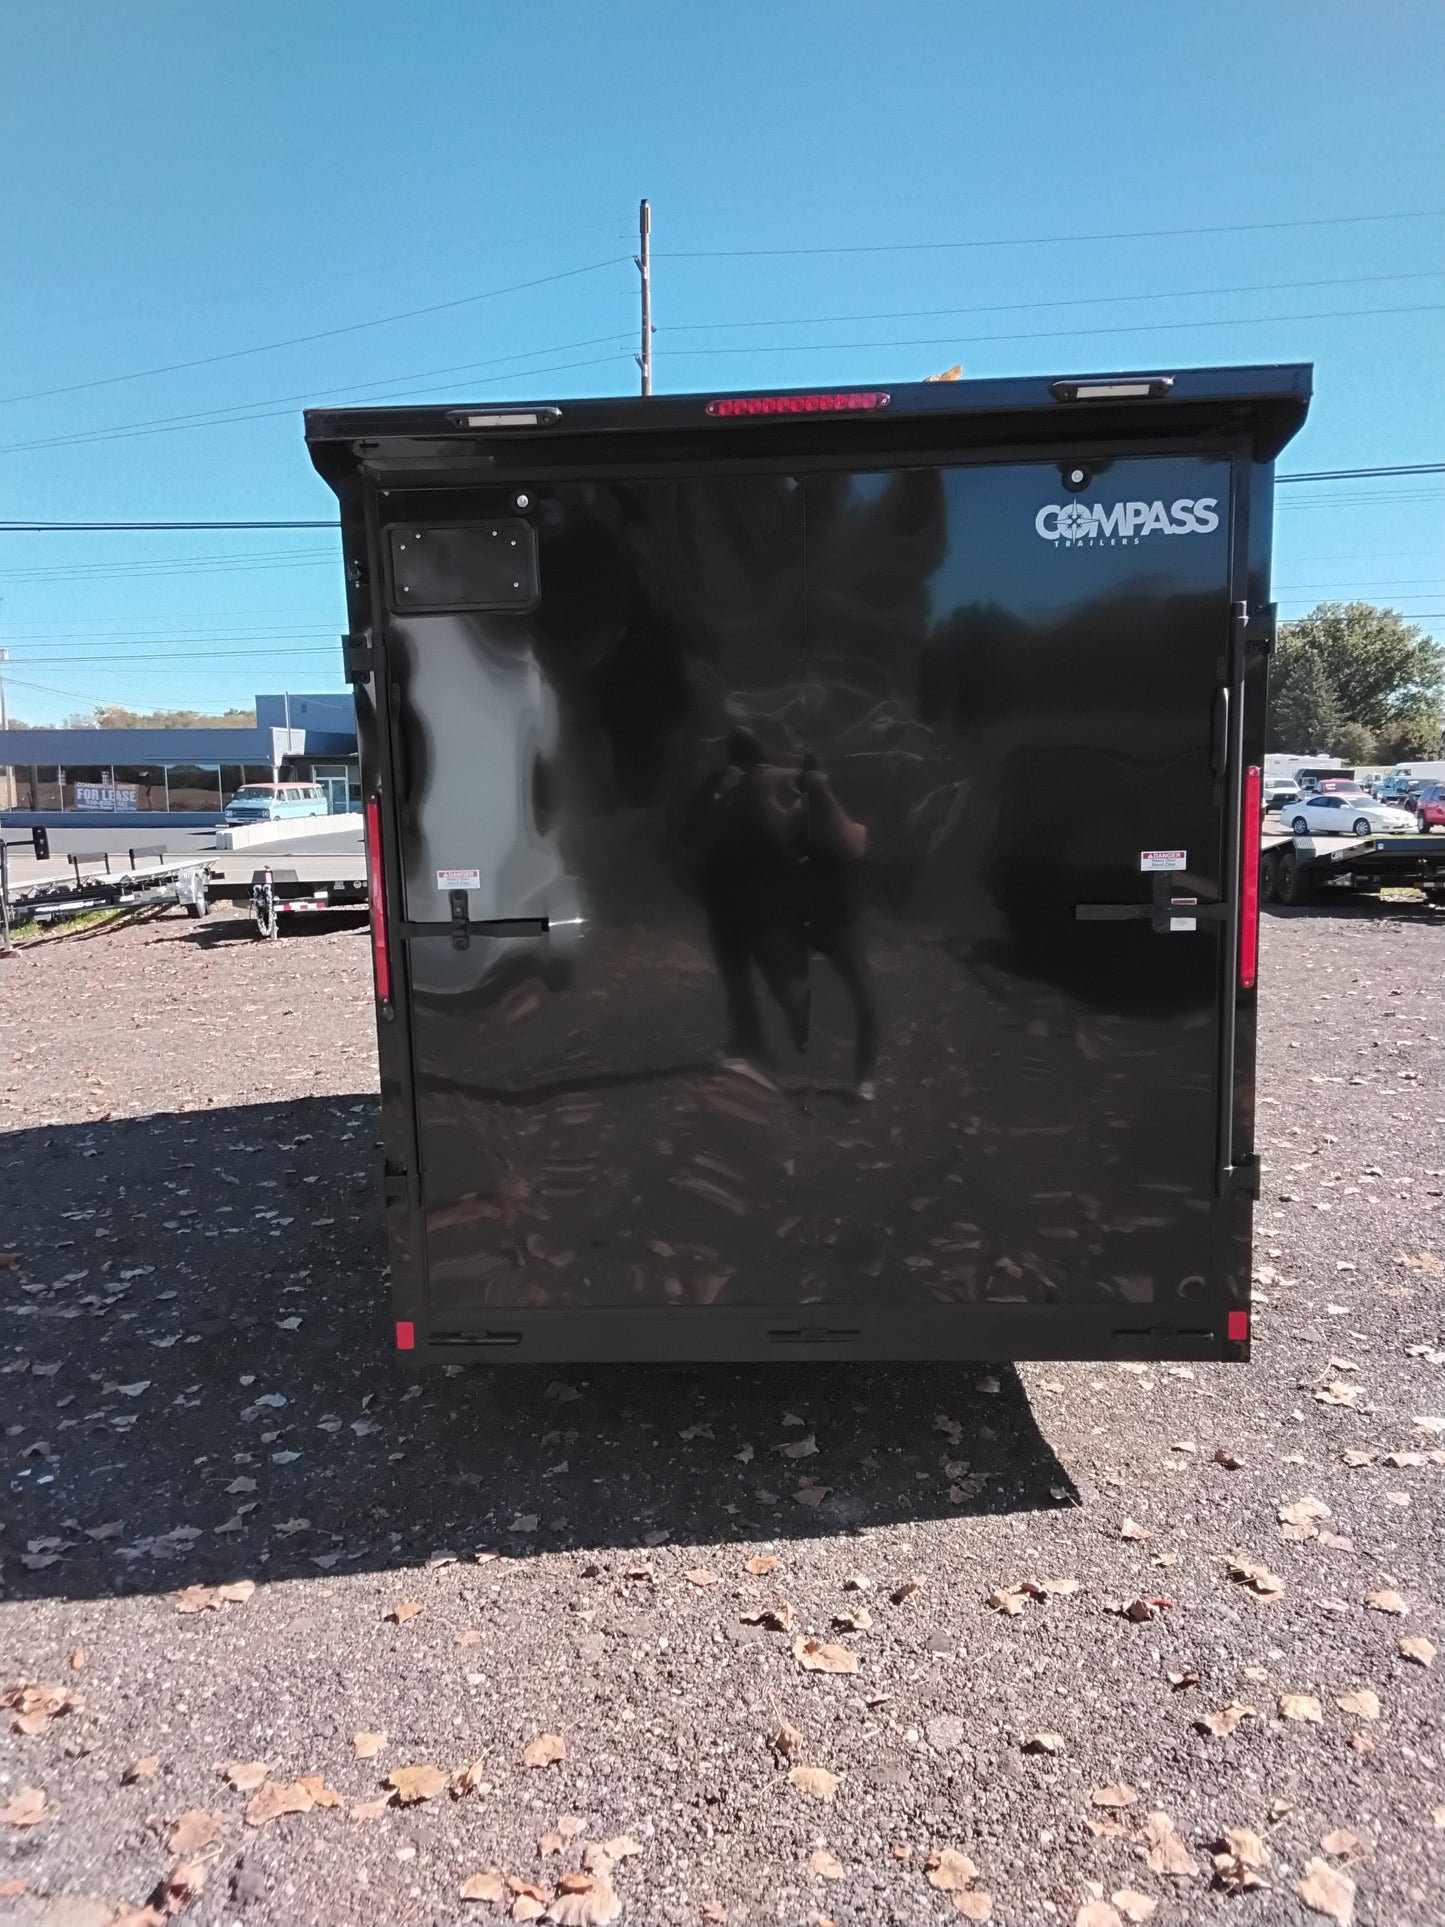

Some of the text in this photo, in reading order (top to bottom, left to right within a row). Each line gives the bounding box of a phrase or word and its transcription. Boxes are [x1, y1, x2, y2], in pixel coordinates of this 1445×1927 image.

[1035, 498, 1219, 540] COMPASS
[1054, 537, 1140, 548] TRAILERS
[77, 788, 137, 802] FOR LEASE
